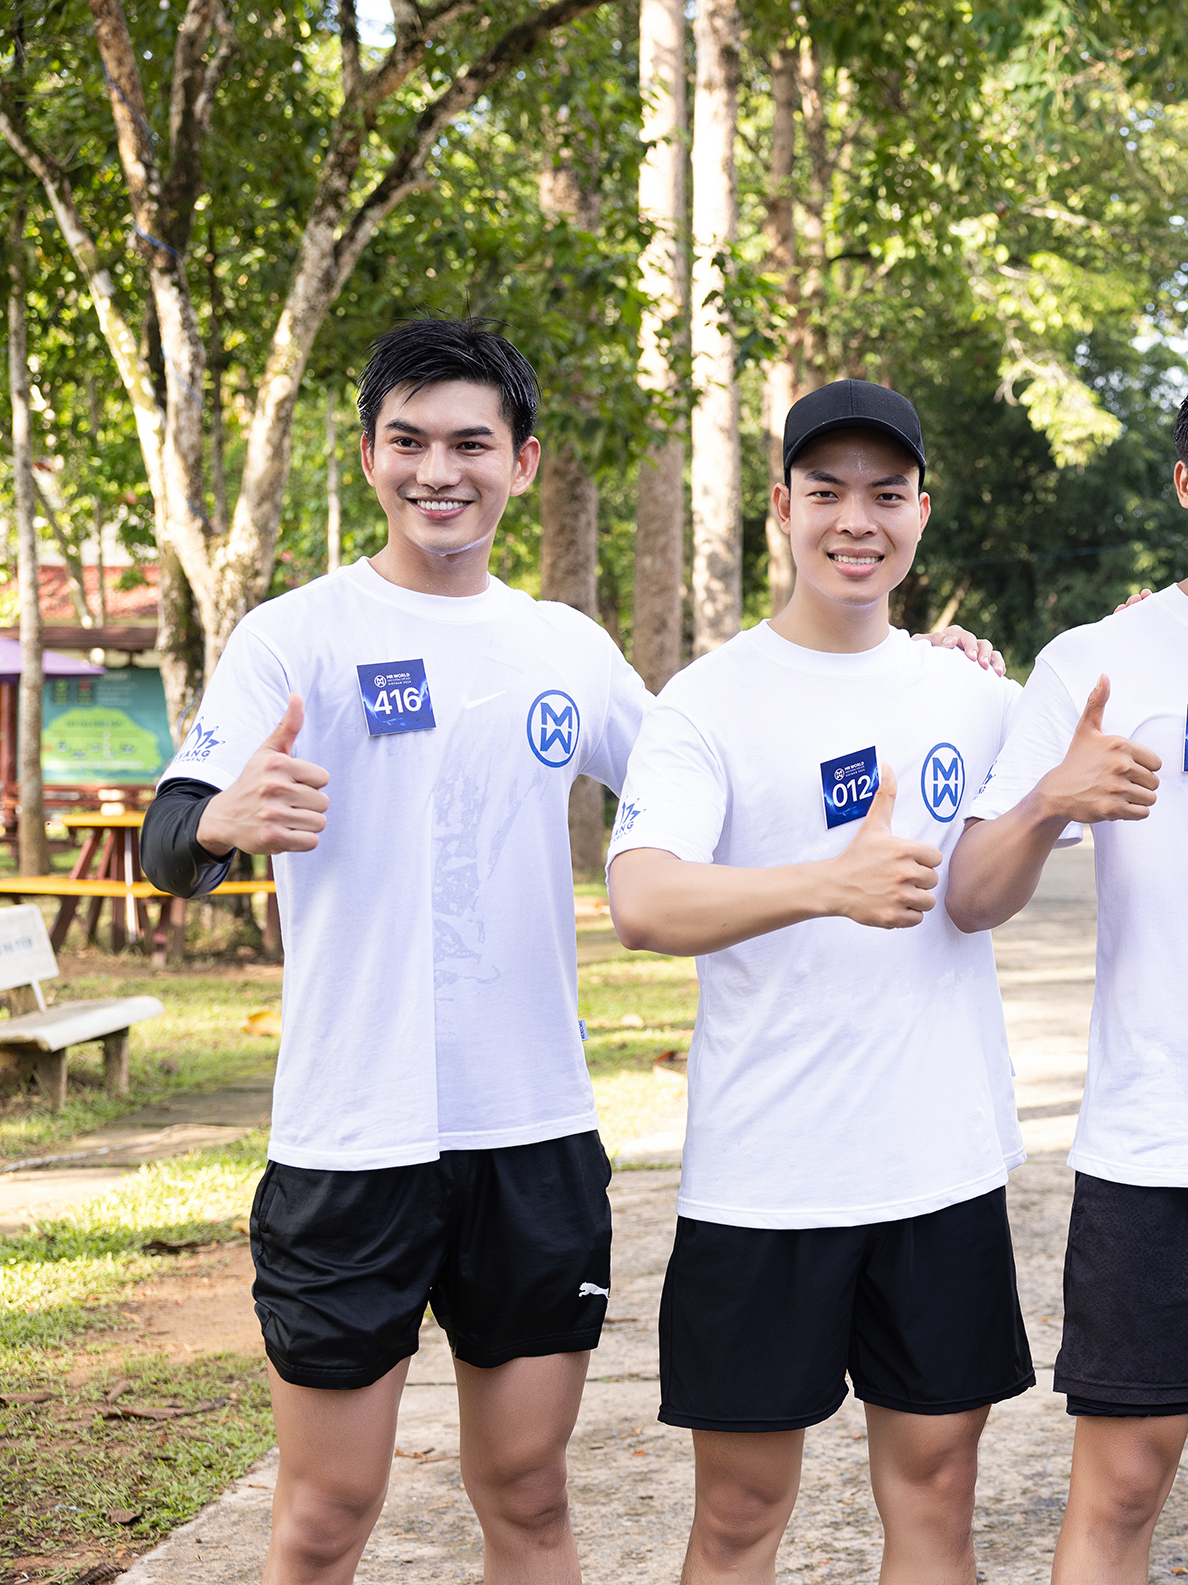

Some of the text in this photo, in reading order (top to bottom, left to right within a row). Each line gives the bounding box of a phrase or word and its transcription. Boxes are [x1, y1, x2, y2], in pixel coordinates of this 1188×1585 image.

[374, 687, 422, 715] 416
[850, 761, 865, 769] WORLD
[832, 774, 873, 807] 012
